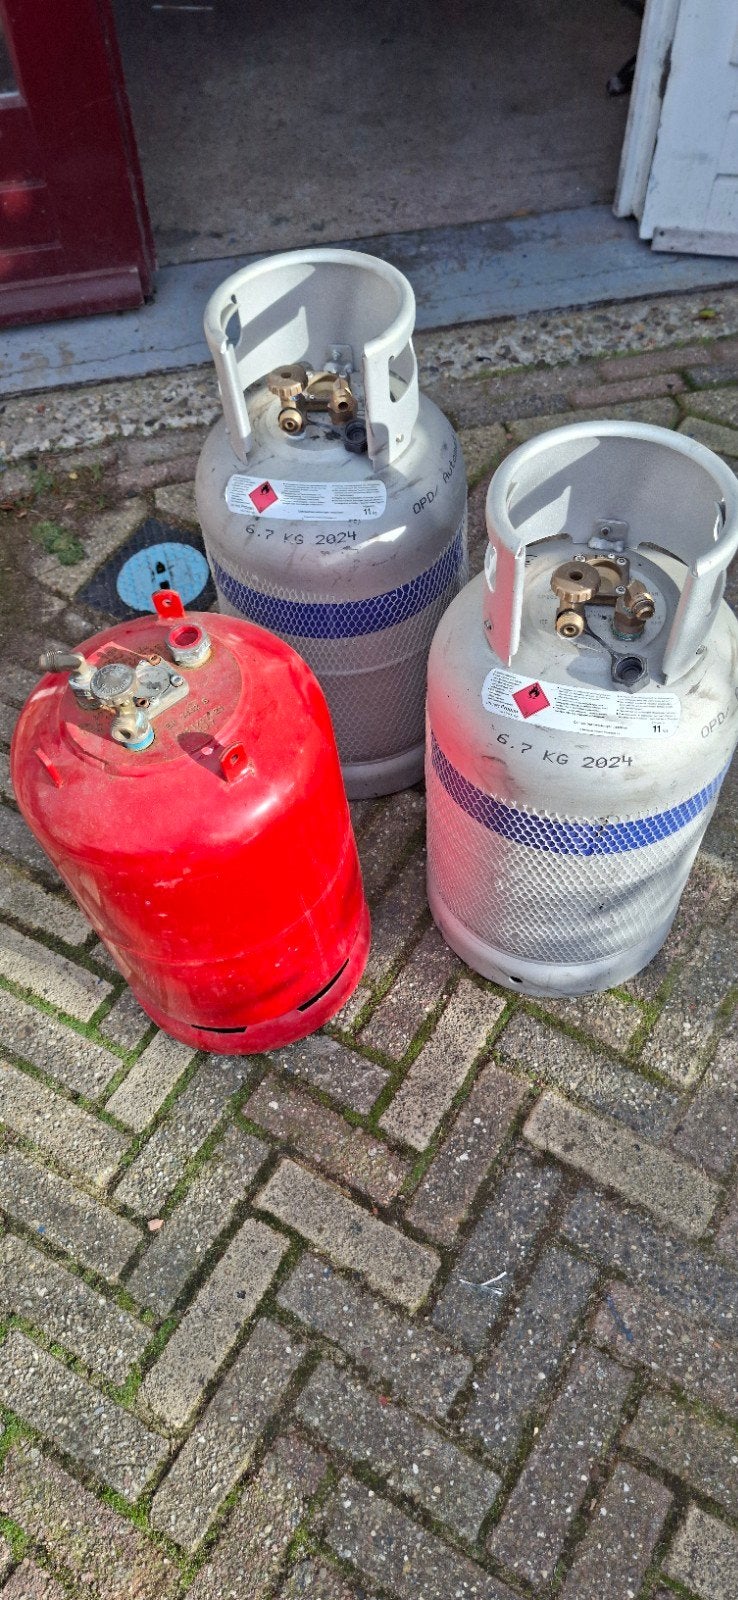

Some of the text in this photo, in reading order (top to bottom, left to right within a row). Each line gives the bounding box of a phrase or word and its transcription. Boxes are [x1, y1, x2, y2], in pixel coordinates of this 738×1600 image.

[245, 523, 357, 545] 6.7 KG 2024
[652, 725, 661, 733] 11
[496, 733, 633, 769] 6.7 KG 2024
